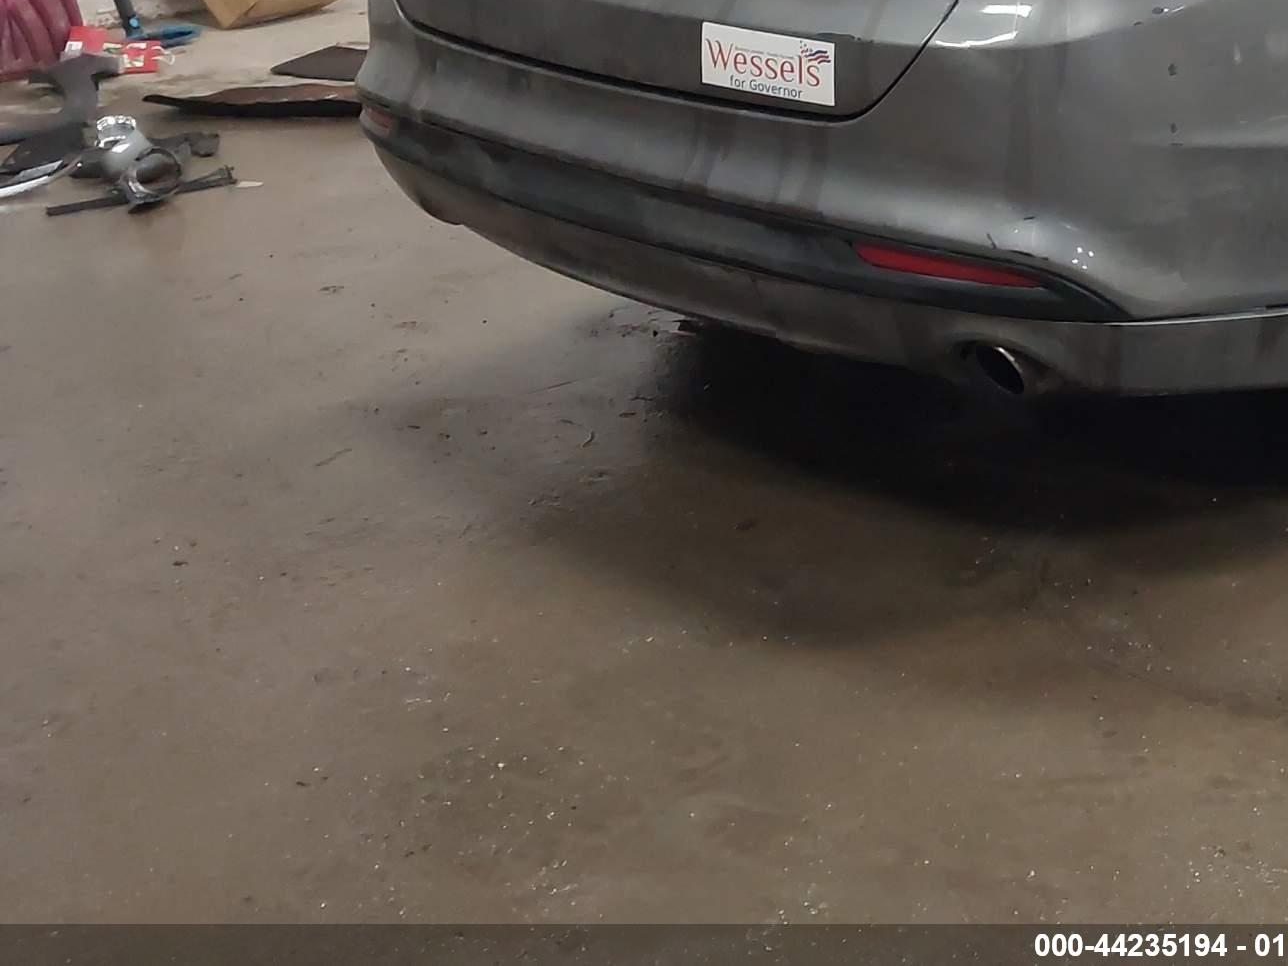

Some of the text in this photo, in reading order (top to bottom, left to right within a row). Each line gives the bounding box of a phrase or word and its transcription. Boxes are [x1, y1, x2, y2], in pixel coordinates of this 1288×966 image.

[705, 38, 820, 87] Wessels
[730, 74, 803, 99] for Governor
